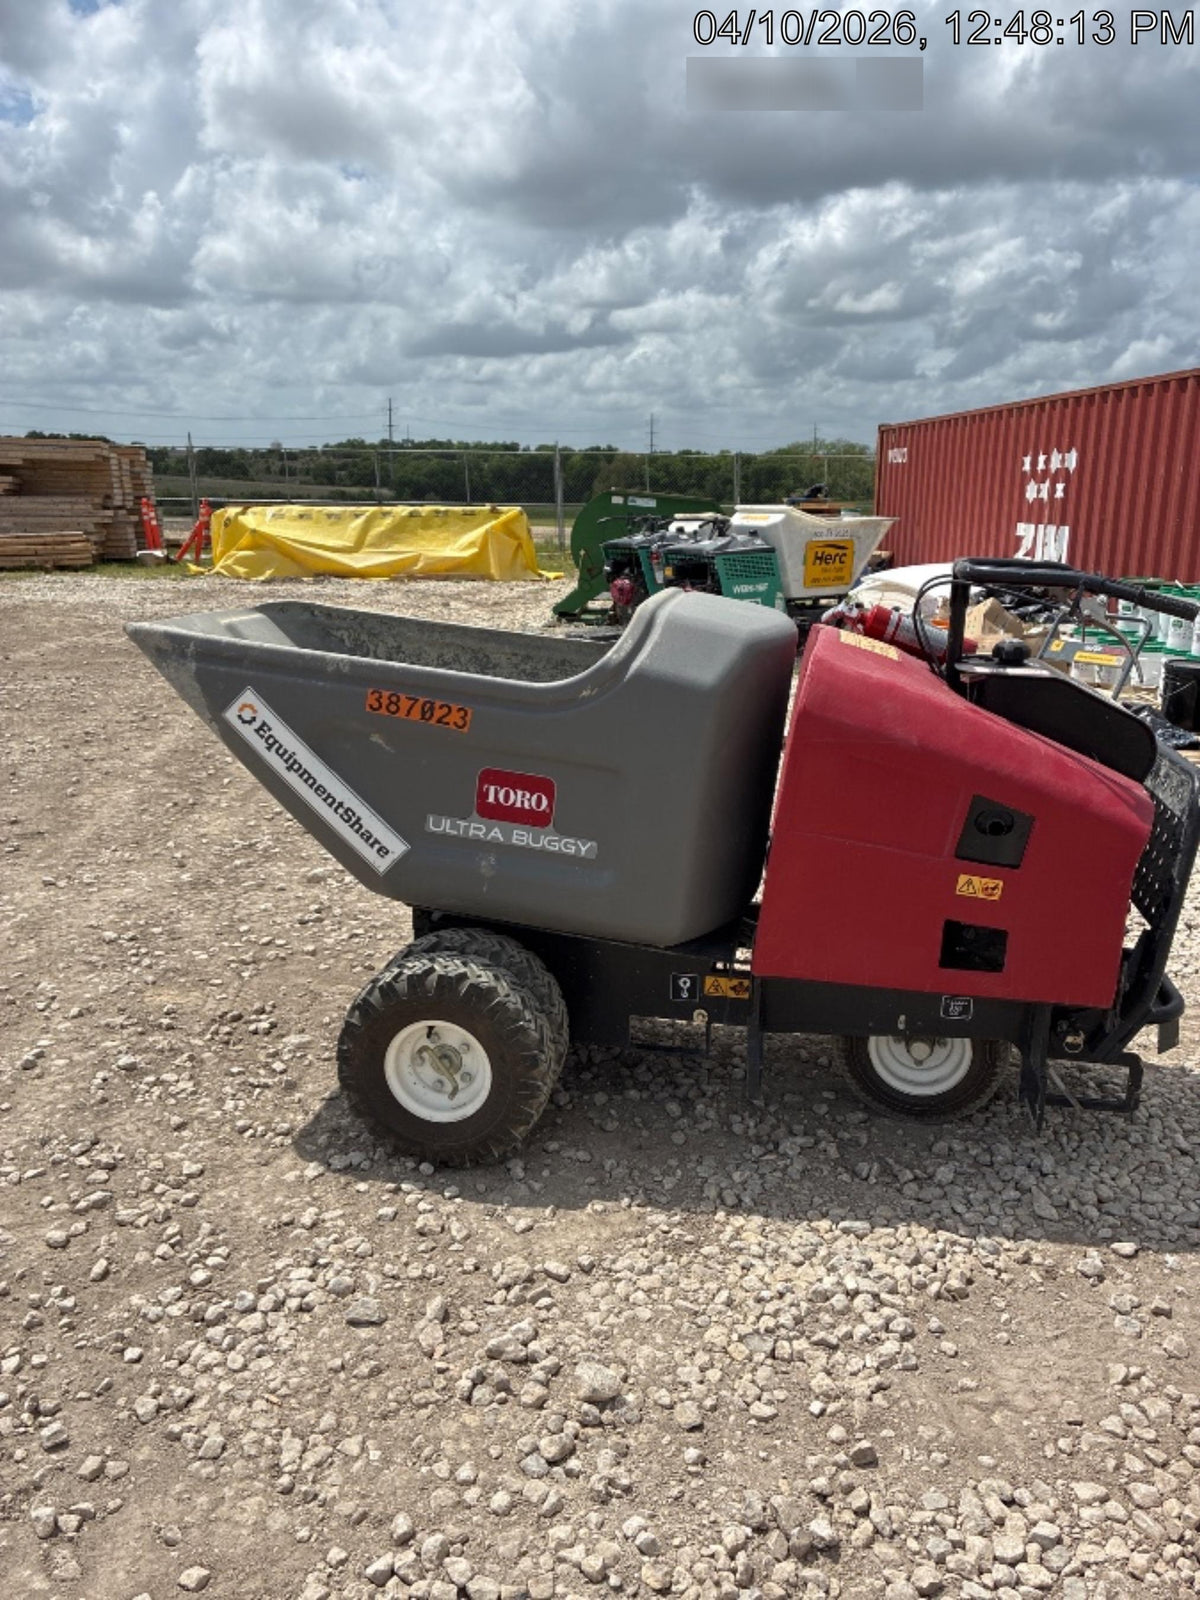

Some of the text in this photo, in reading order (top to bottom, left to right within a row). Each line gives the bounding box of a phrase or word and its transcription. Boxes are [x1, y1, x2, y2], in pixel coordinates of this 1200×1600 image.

[812, 550, 848, 566] Herc
[367, 689, 468, 730] 387023
[253, 719, 391, 859] EquipmentShare
[482, 783, 549, 813] TORO
[428, 816, 592, 856] ULTRA BUGGY
